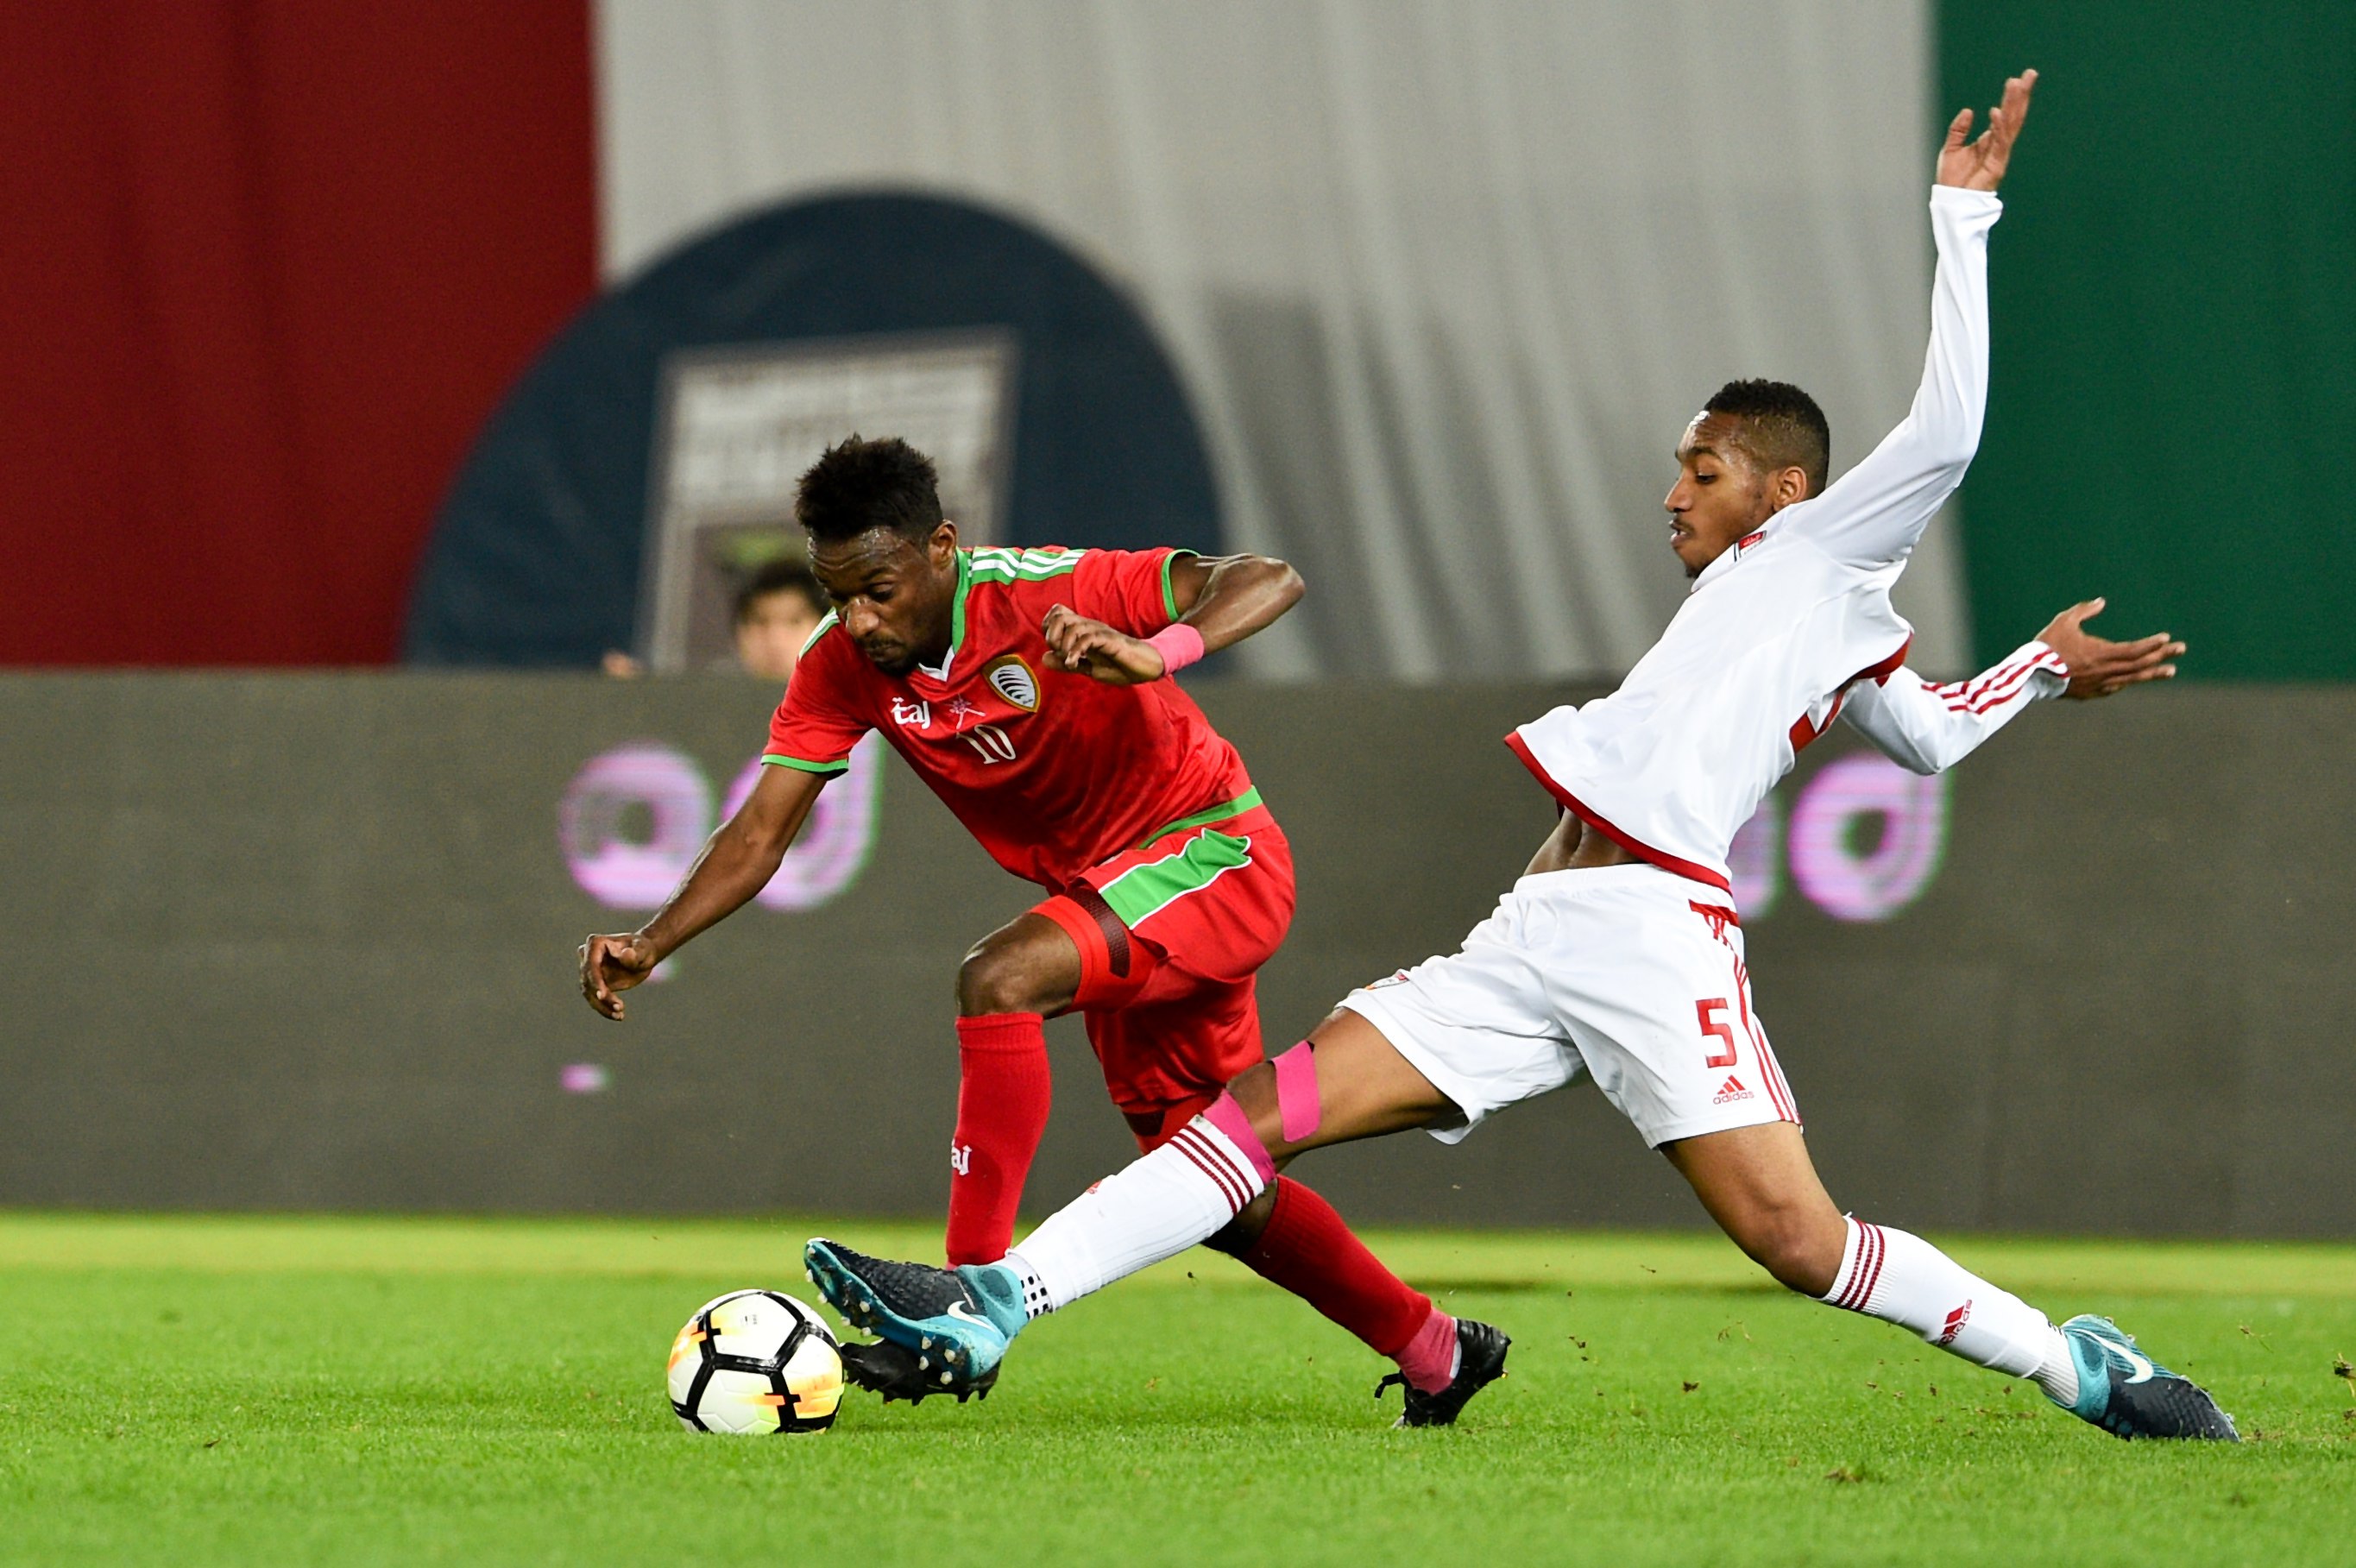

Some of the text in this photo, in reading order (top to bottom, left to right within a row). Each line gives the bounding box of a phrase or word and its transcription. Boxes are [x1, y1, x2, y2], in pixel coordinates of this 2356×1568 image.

[891, 696, 930, 729] taj
[955, 724, 1017, 765] 10
[1696, 998, 1737, 1068] 5
[1712, 1091, 1754, 1105] adidas
[951, 1144, 973, 1175] aj
